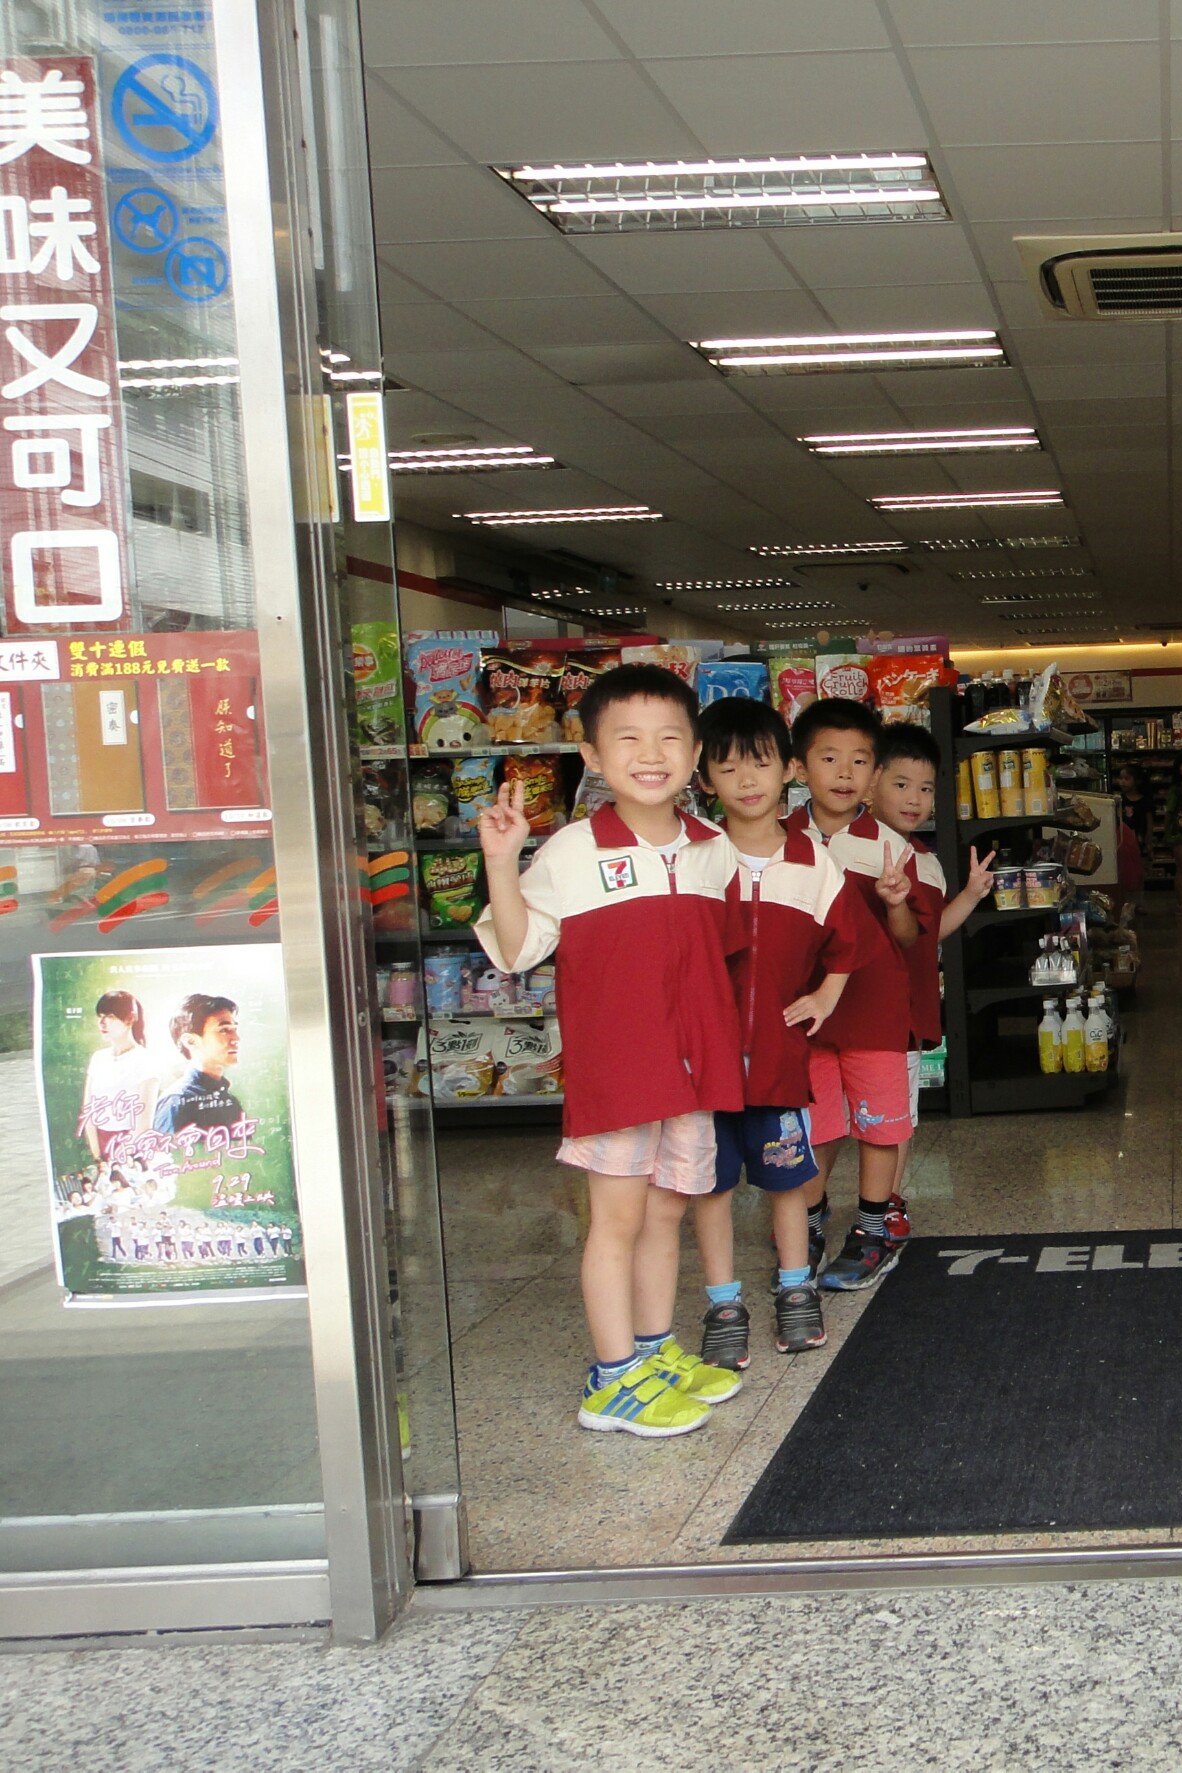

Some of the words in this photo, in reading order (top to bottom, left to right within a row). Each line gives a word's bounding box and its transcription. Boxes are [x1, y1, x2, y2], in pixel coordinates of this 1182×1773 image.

[0, 70, 122, 623] 美味又可口
[69, 640, 148, 660] 雙十連假
[824, 679, 868, 691] Crunch
[829, 671, 862, 682] Fruit
[876, 667, 940, 691] パンケーキ
[830, 687, 864, 697] Rolls
[214, 698, 236, 778] 朕知道了
[607, 860, 627, 888] 7
[77, 1090, 146, 1137] 老師
[104, 1112, 266, 1165] 你會不會回來
[211, 1172, 252, 1195] 9.29
